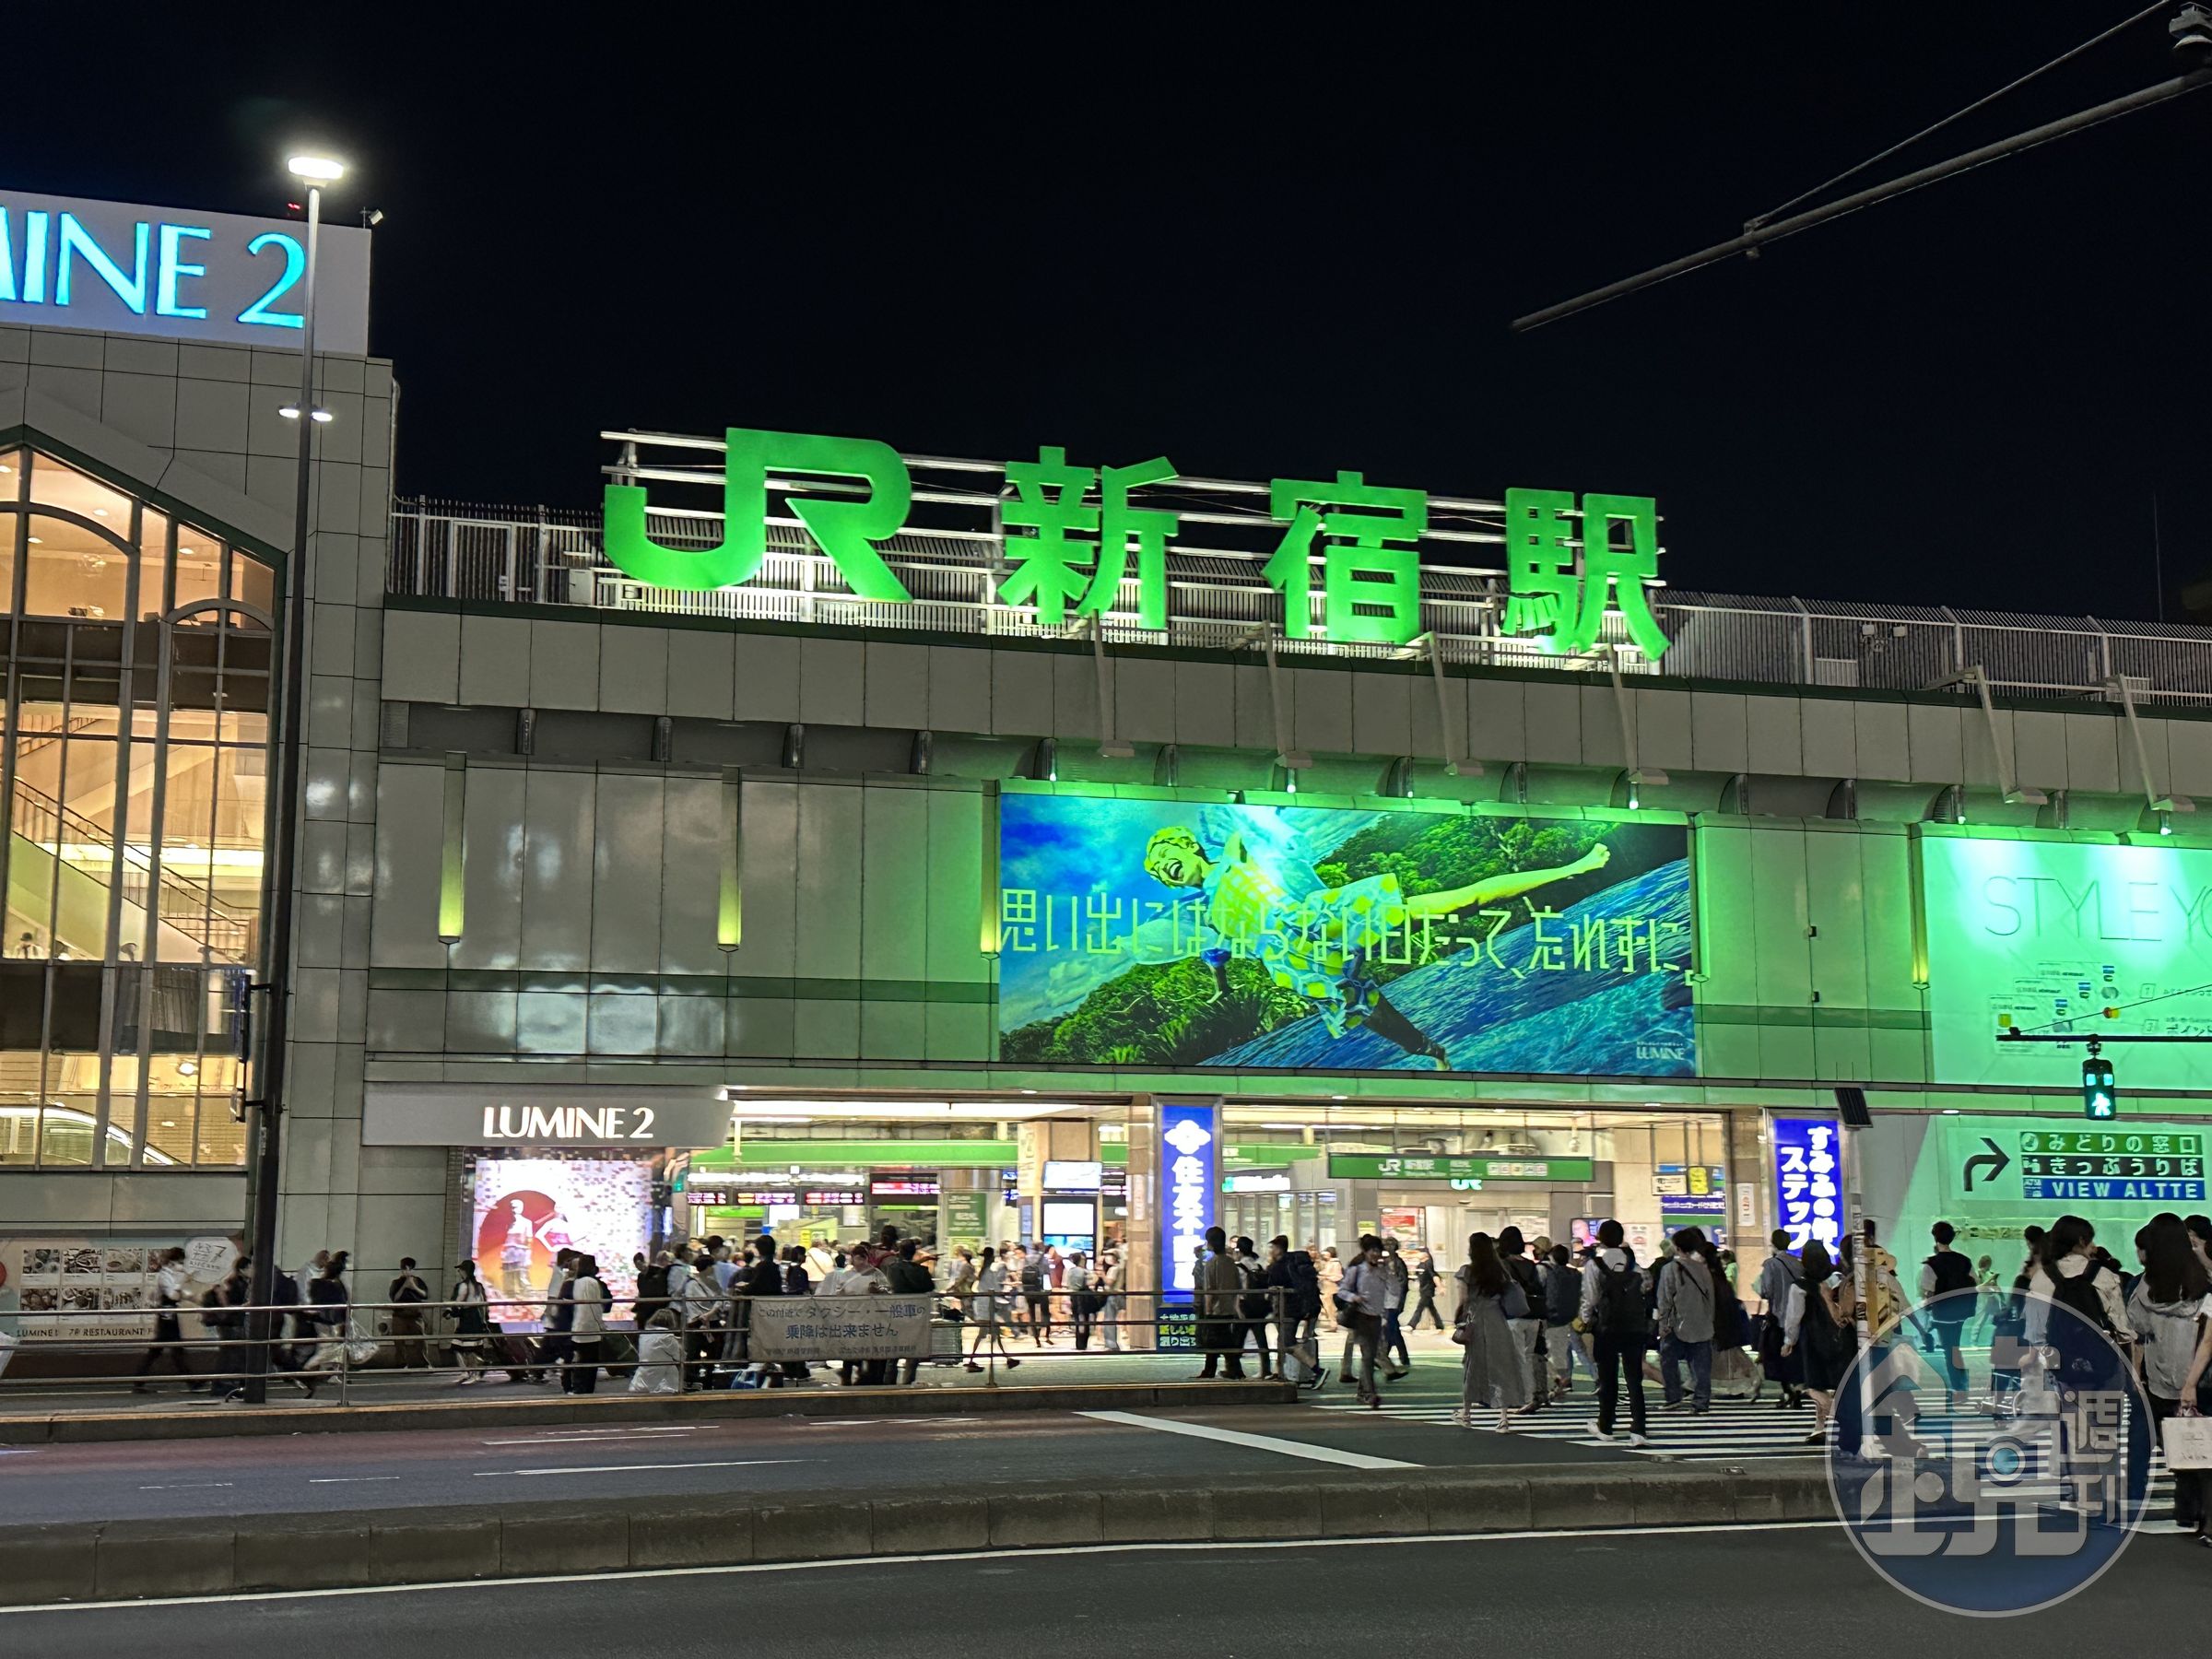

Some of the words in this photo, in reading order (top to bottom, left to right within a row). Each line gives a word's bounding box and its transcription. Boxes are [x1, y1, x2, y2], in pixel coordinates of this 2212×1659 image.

[236, 231, 306, 329] 2
[483, 1106, 626, 1139] LUMINE
[629, 1107, 655, 1139] 2
[2048, 1134, 2196, 1154] みどりの窓口
[2049, 1158, 2199, 1177] きっぷうりば
[2052, 1181, 2112, 1197] VIEW
[2124, 1182, 2199, 1199] ALTTE
[83, 1327, 144, 1336] RESTAURANT
[785, 1324, 899, 1339] 乗降は出来ません
